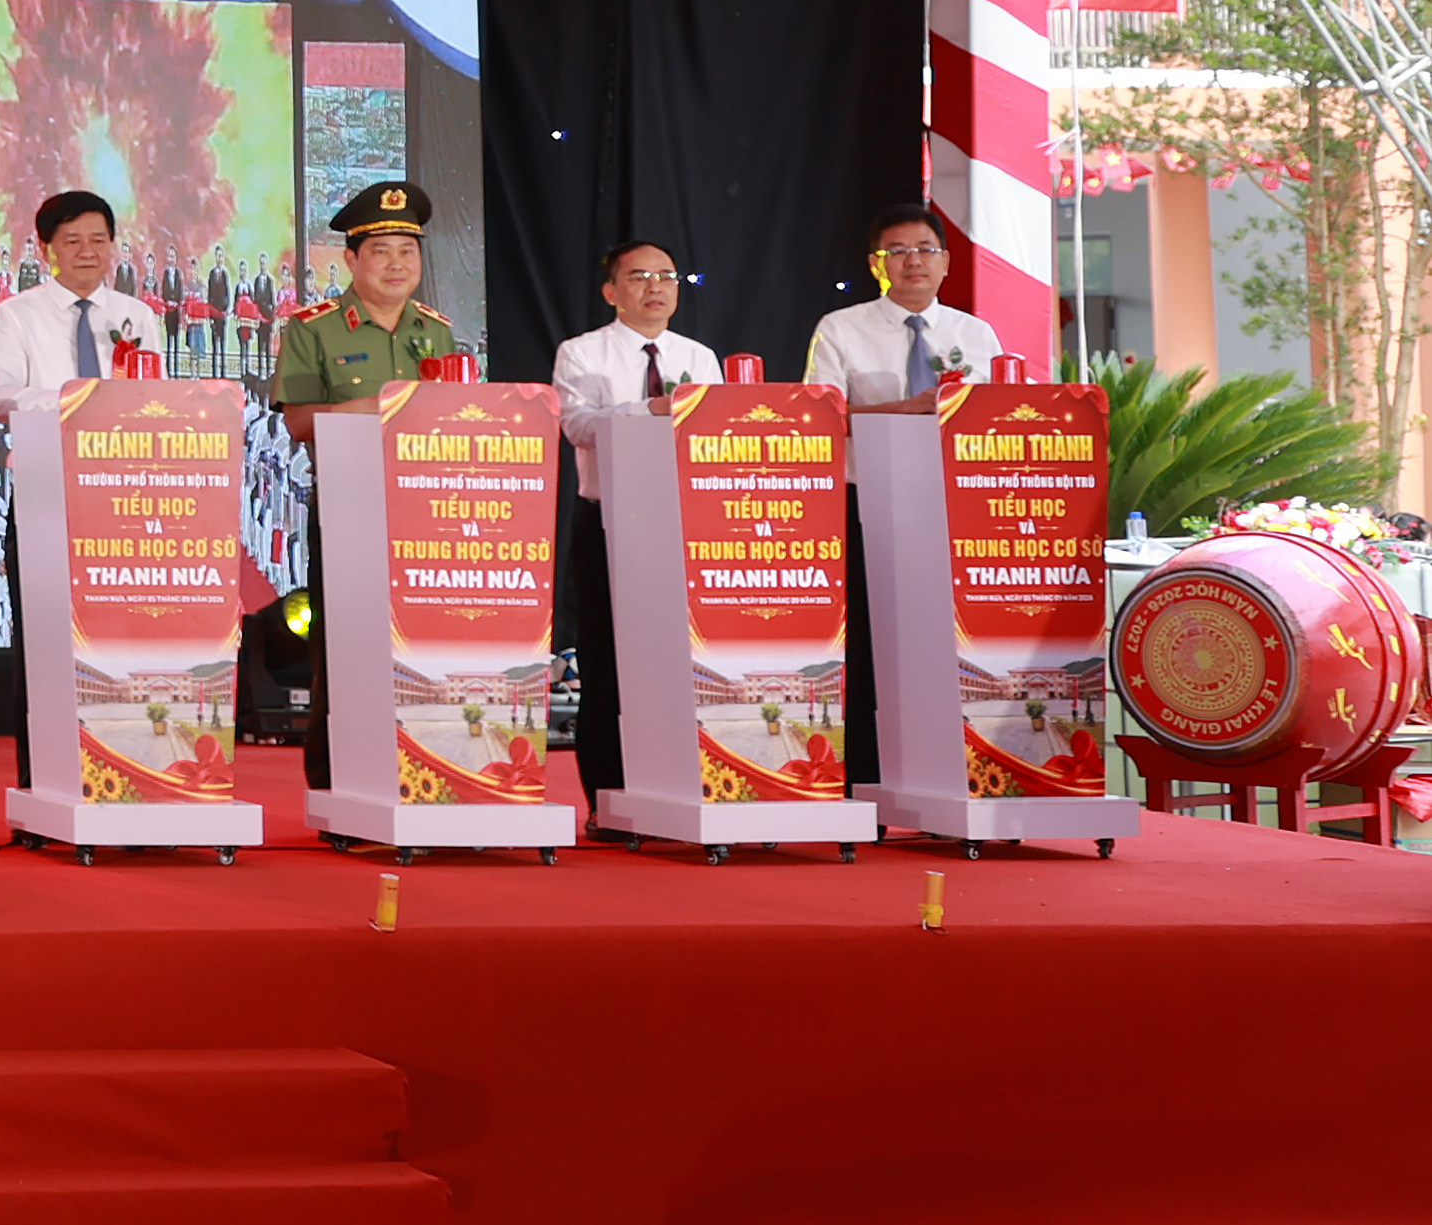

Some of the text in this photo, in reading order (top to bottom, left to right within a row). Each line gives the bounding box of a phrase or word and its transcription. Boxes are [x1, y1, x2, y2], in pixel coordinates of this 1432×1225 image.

[76, 424, 229, 459] KHÁNH THÀNH
[396, 427, 543, 464] KHÁNH THÀNH
[689, 429, 832, 463] KHÁNH THÀNH
[954, 428, 1094, 461] KHÁNH THÀNH
[405, 567, 536, 590] THANH NƯA
[967, 564, 1091, 586] THANH NƯA
[1186, 580, 1221, 596] HỌC
[1147, 585, 1184, 612] 2026
[1221, 588, 1260, 620] NĂM
[1126, 615, 1150, 653] 2027
[1159, 706, 1223, 738] GIẢNG
[1224, 704, 1267, 733] KHAI
